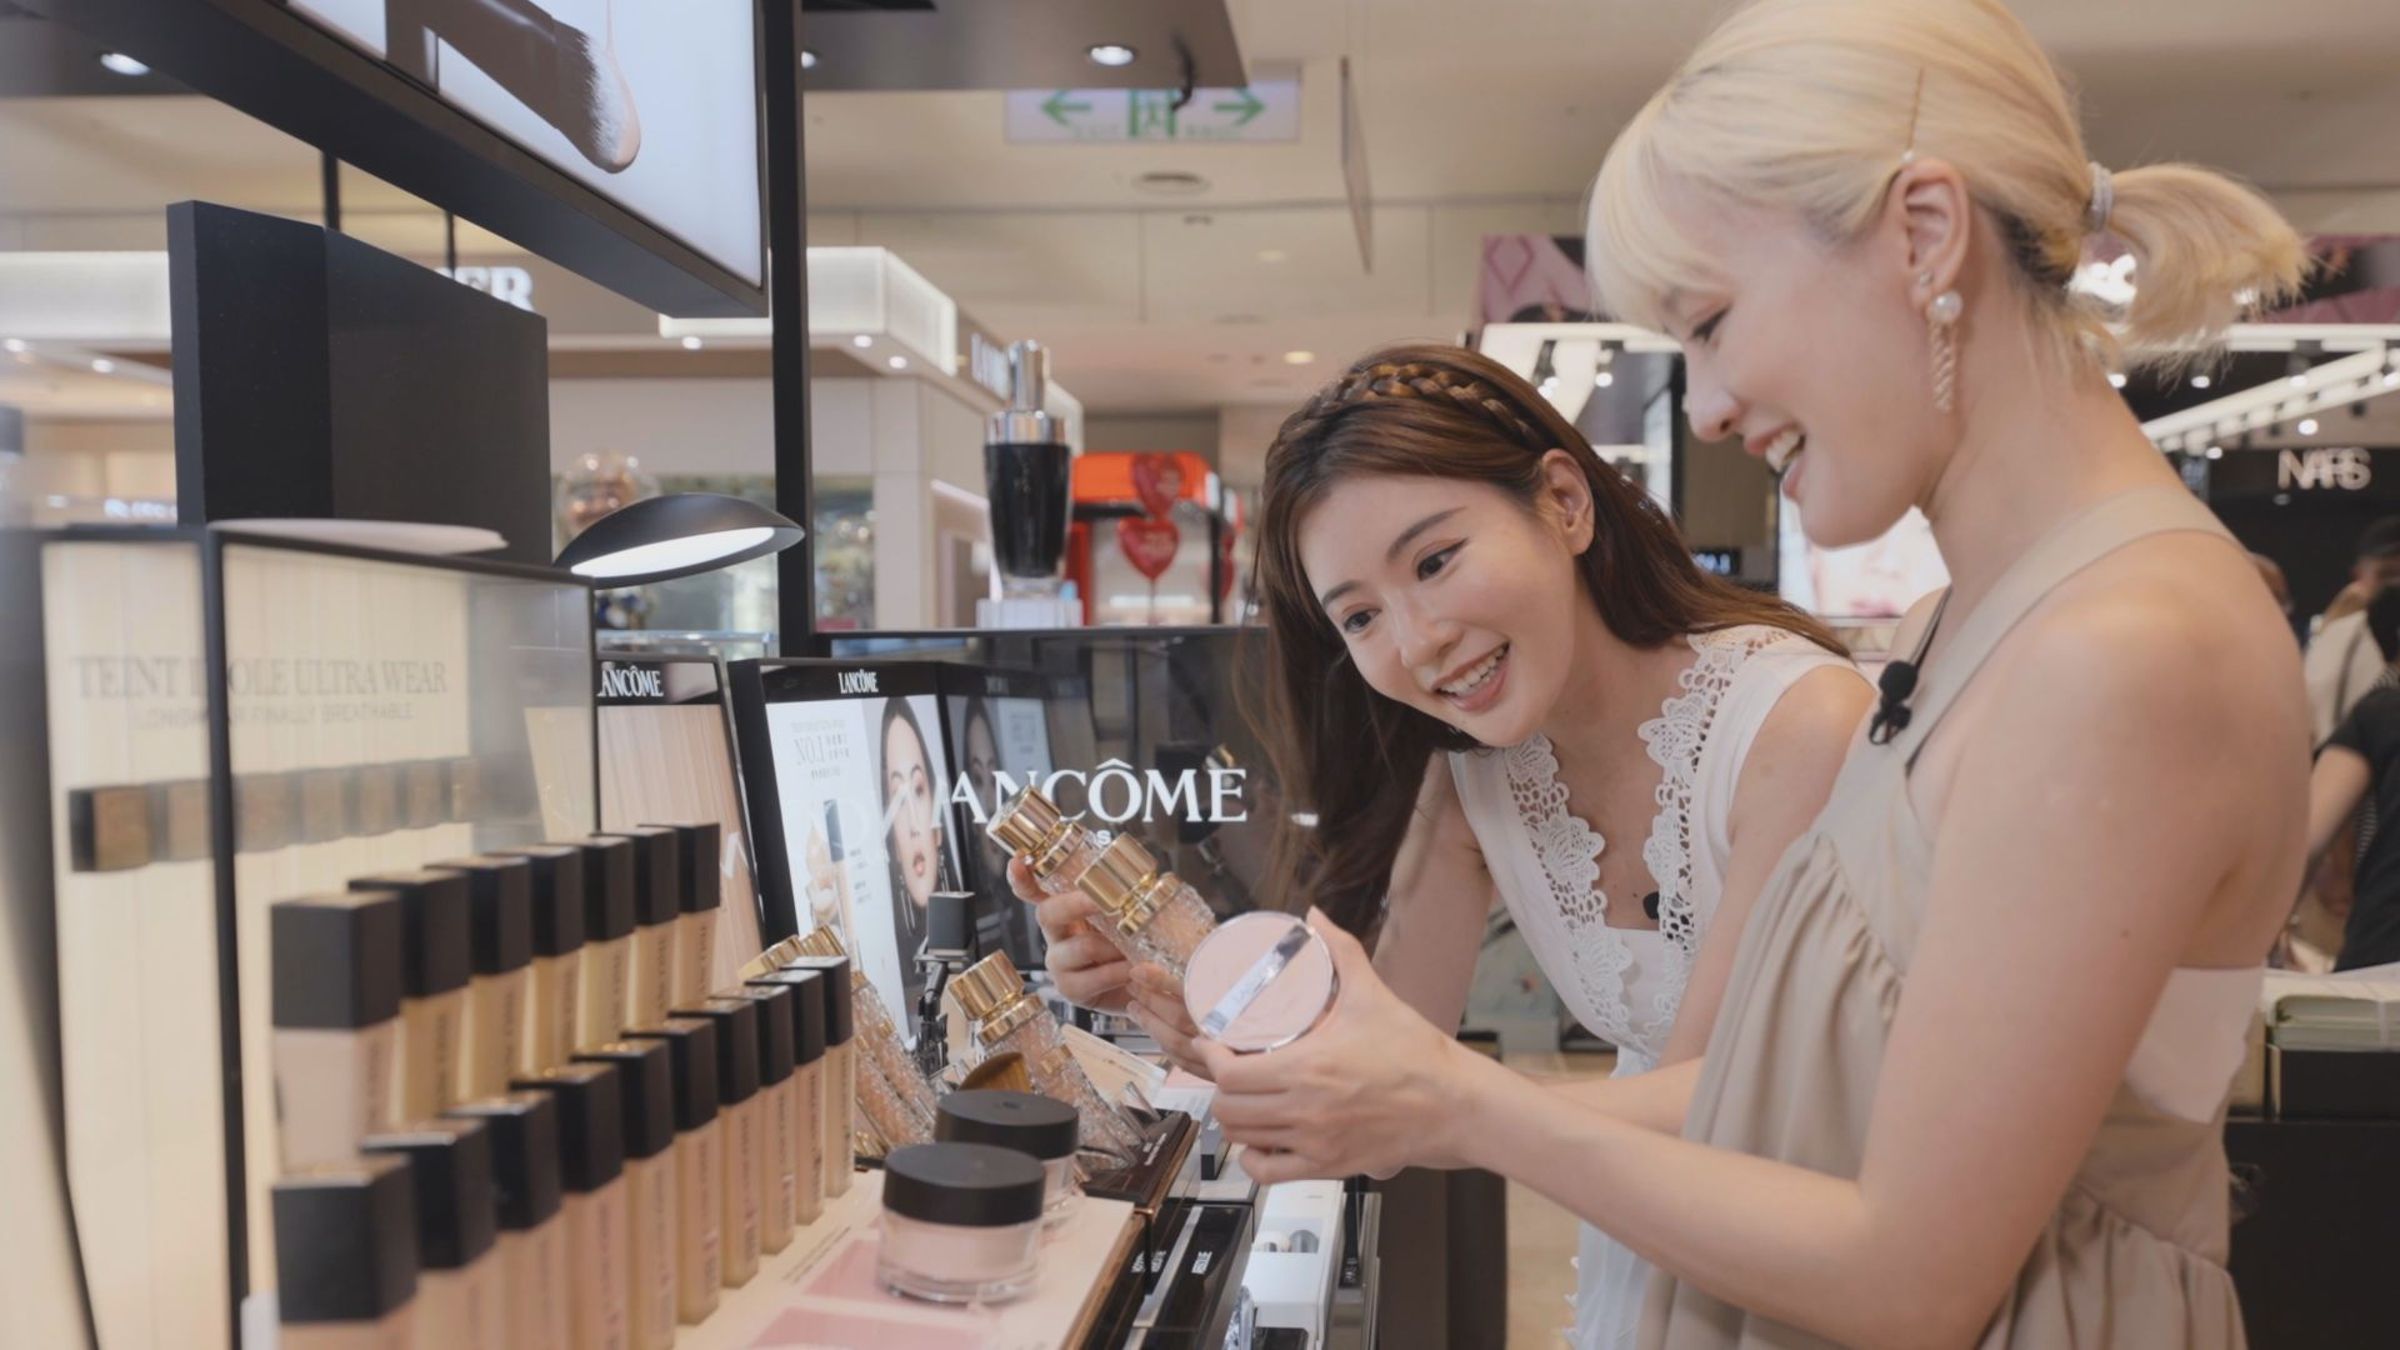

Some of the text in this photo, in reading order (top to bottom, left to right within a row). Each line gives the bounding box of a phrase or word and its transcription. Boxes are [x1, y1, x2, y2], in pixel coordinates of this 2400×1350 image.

[71, 655, 183, 699] TEINT
[294, 658, 376, 696] ULTRA
[380, 660, 449, 694] WEAR
[950, 758, 1248, 824] ANCÔME
